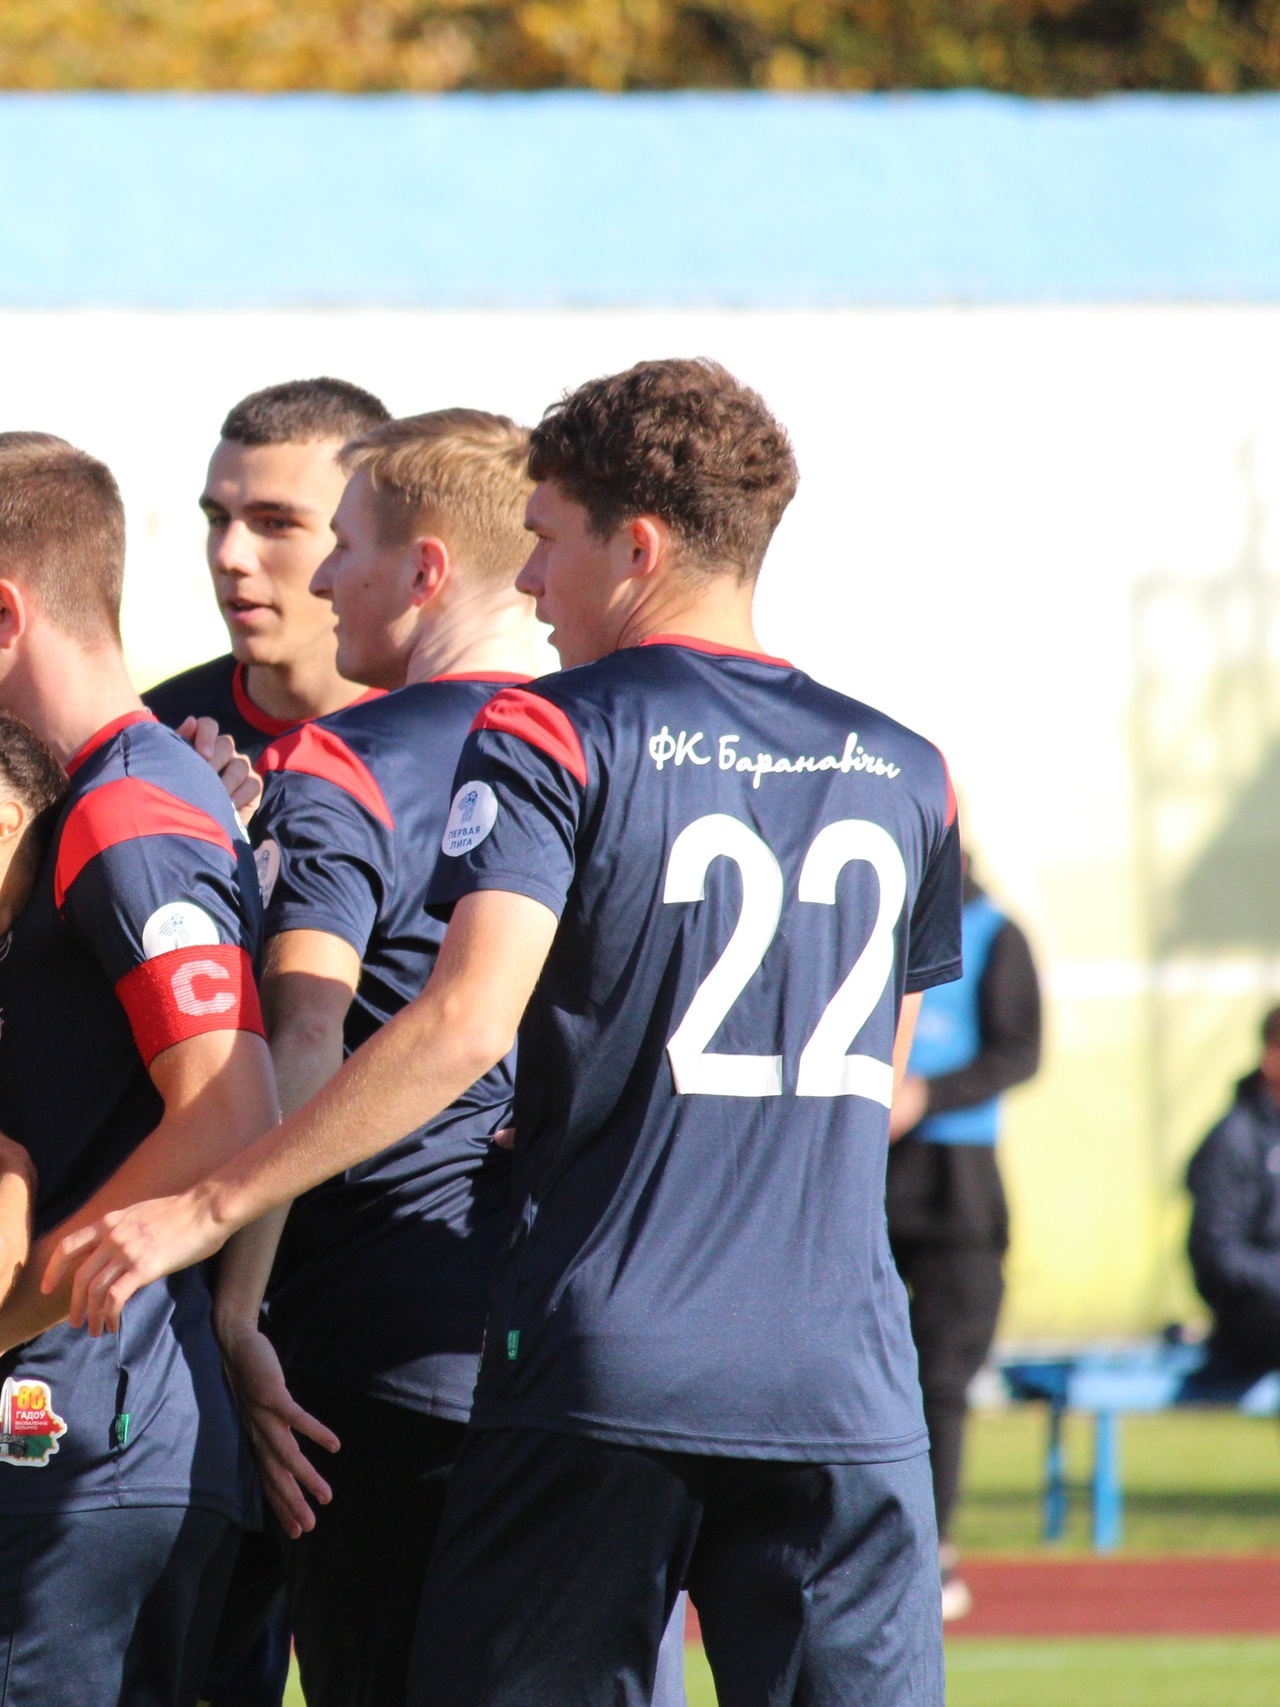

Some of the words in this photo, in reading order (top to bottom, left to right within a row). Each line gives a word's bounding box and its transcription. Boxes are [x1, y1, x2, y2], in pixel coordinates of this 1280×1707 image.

[649, 726, 711, 771] ФК
[718, 732, 901, 789] Баранавічы
[448, 826, 480, 840] ПЕРВАЯ
[449, 838, 473, 850] ЛИГА
[663, 813, 907, 1109] 22
[171, 960, 236, 1017] C
[17, 1385, 44, 1410] 80
[15, 1410, 46, 1421] ГАДОЎ
